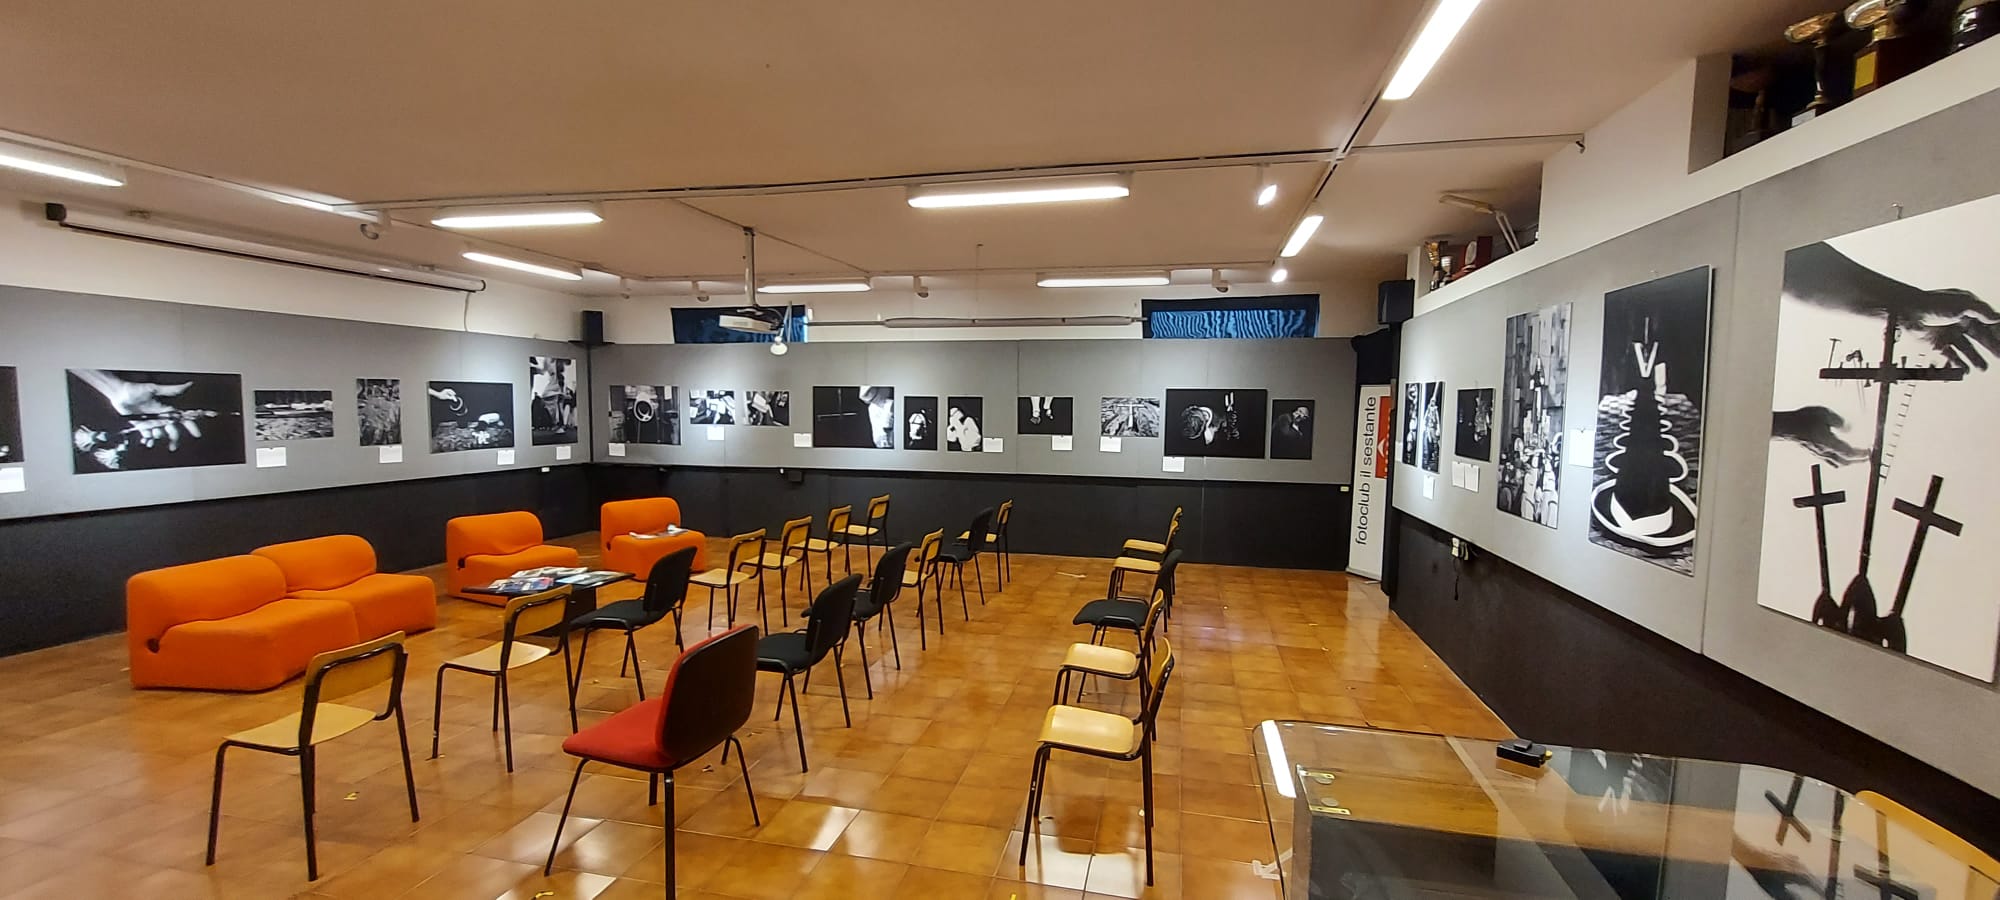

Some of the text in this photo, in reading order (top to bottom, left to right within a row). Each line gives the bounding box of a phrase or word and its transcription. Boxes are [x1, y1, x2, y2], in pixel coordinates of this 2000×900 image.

[1355, 396, 1377, 545] fotoclub il sestante
